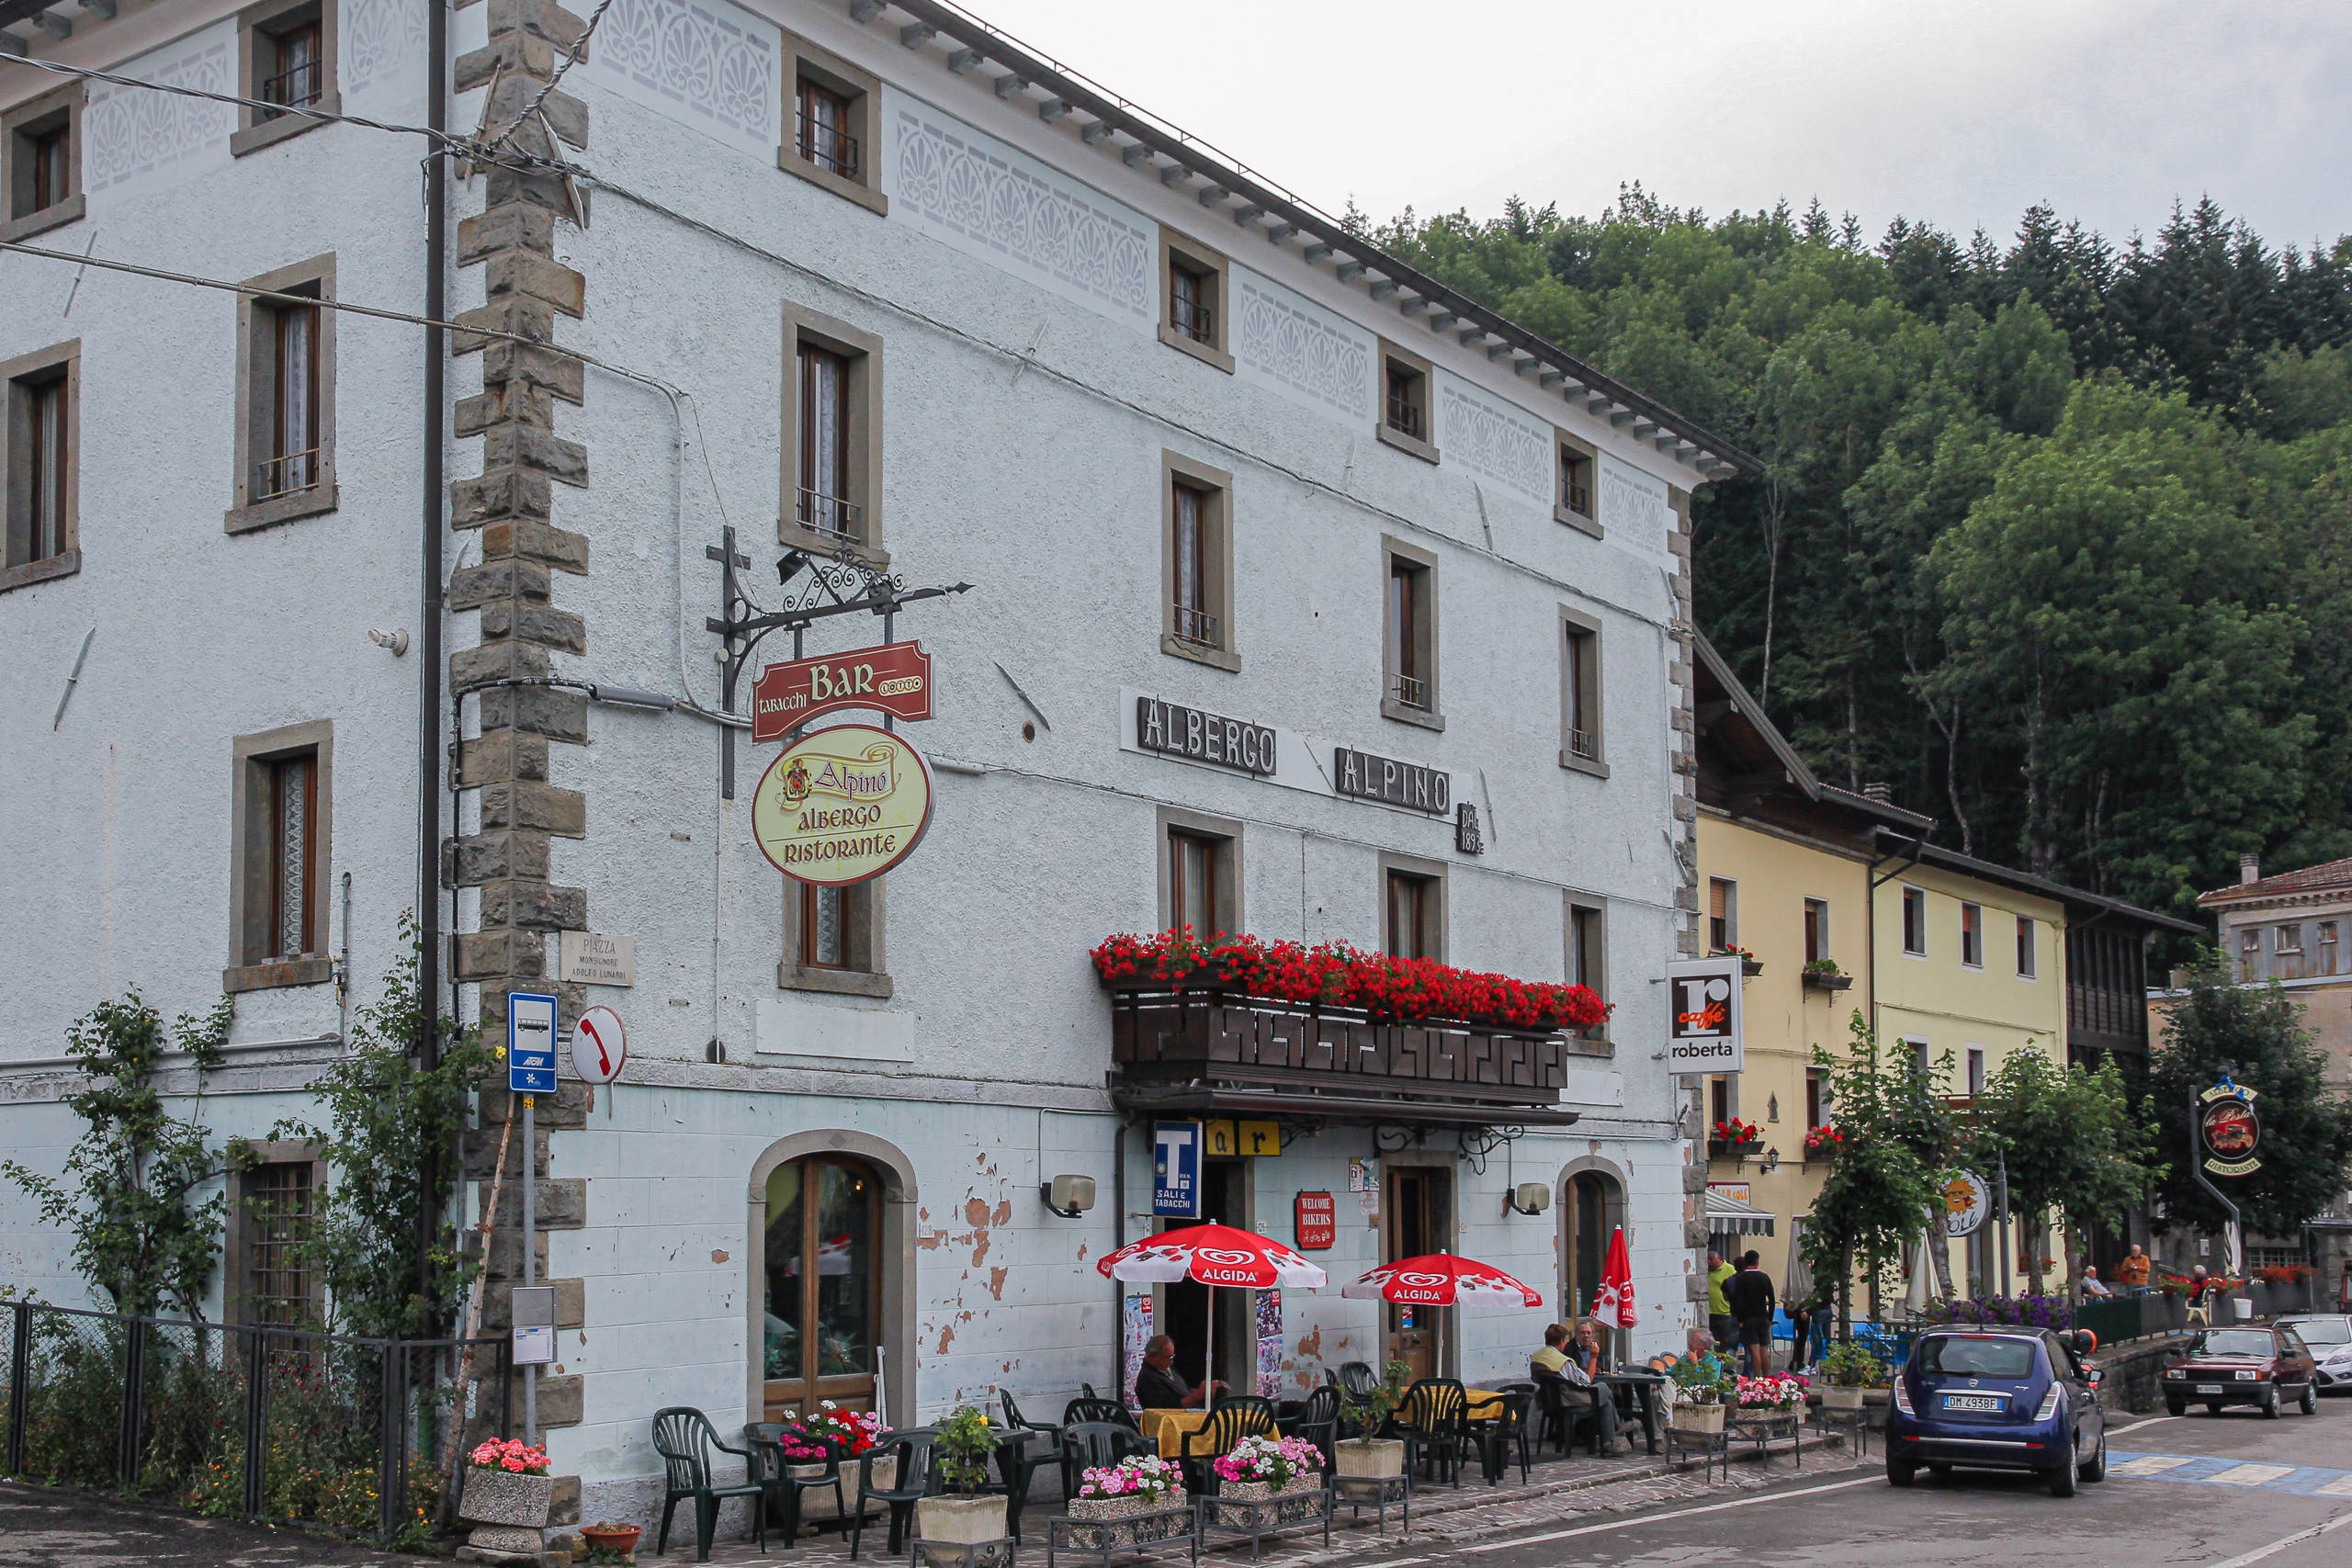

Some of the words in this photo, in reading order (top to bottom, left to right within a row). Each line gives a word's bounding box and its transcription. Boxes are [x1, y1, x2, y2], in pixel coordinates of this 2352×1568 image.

[881, 678, 922, 694] LOTTO
[1144, 698, 1275, 773] ALBERGO
[1343, 750, 1448, 811] ALPINO
[815, 761, 888, 802] Alpino
[797, 804, 882, 832] ALBERGO
[1462, 809, 1478, 829] DAL
[784, 832, 897, 864] RISTORANTE
[1461, 830, 1482, 853] 1893
[583, 938, 616, 954] PIAZZA
[579, 955, 618, 967] MONSIGNORE
[571, 967, 597, 977] ADOLFO
[599, 969, 626, 980] LUNARDI
[1678, 1002, 1726, 1030] caffè
[1672, 1041, 1733, 1058] roberta
[1215, 1131, 1267, 1154] ar
[1156, 1130, 1192, 1190] T
[2208, 1160, 2258, 1173] RISTORANTE
[1157, 1190, 1179, 1199] SALI
[1155, 1199, 1191, 1209] TABACCHI
[1301, 1198, 1330, 1210] WELCOME
[1302, 1213, 1331, 1225] BIKERS
[1948, 1212, 1979, 1234] OLE
[922, 1224, 933, 1235] 128
[1202, 1269, 1257, 1282] ALGIDA
[1393, 1290, 1441, 1302] ALGIDA
[1949, 1396, 1962, 1408] DM
[1965, 1398, 1997, 1409] 493BF
